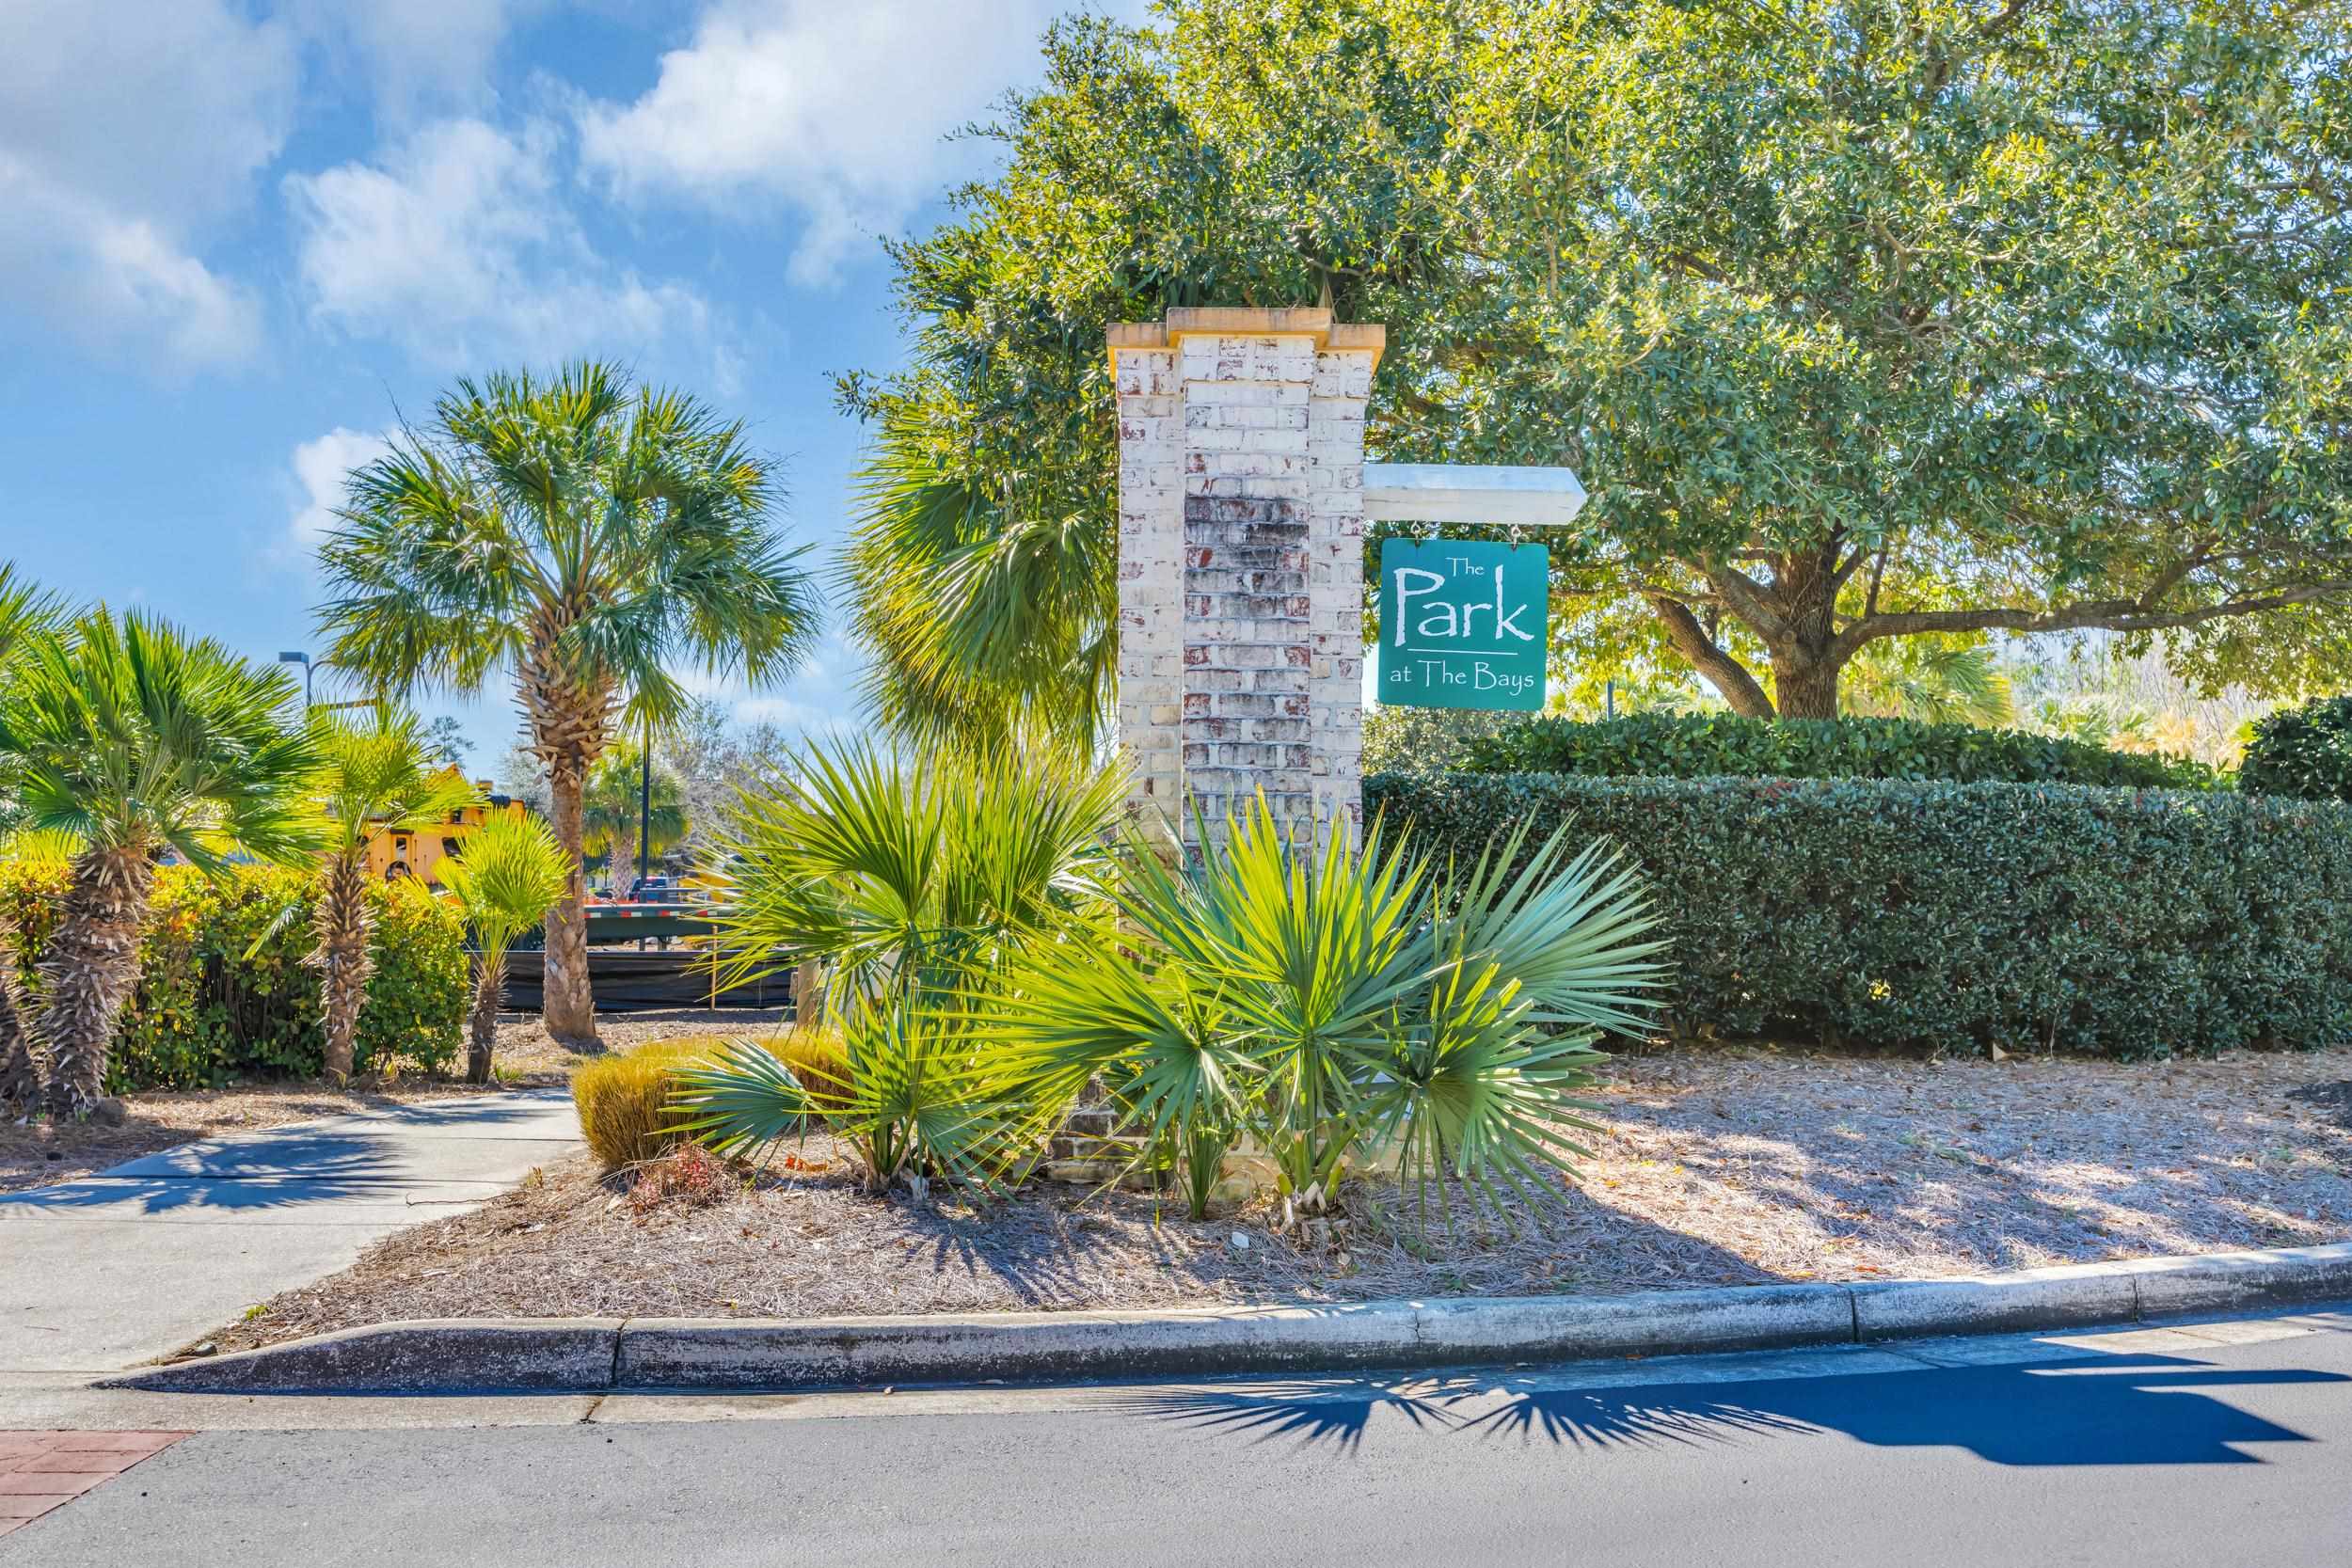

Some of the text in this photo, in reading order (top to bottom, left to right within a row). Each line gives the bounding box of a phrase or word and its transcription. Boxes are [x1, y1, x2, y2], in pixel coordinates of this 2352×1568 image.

[1445, 557, 1485, 577] The
[1393, 564, 1535, 647] Park
[1390, 659, 1534, 696] at The Bays
